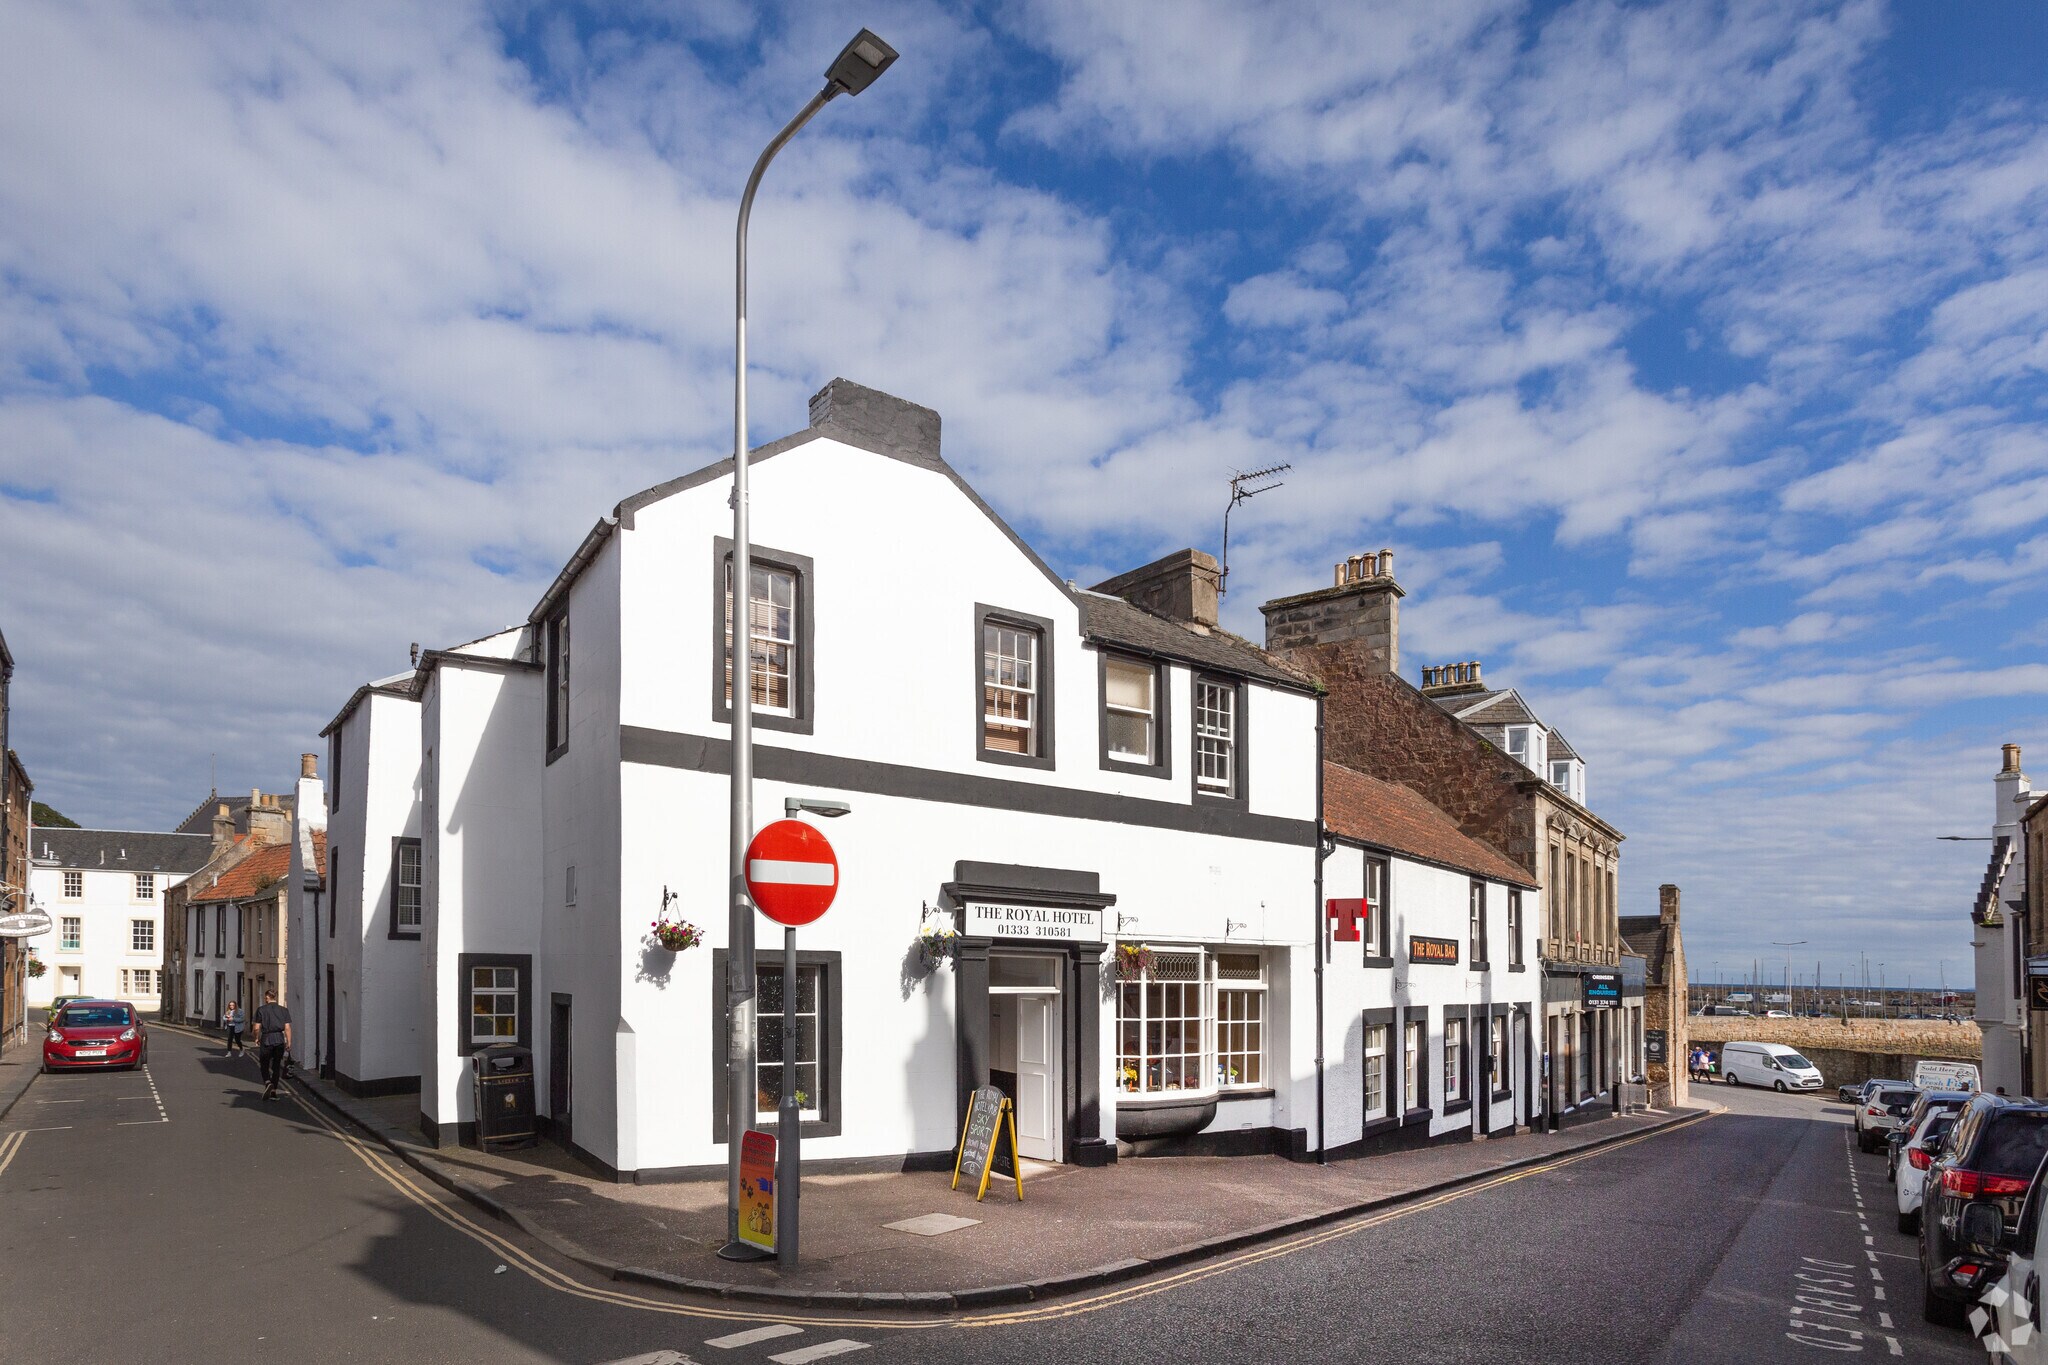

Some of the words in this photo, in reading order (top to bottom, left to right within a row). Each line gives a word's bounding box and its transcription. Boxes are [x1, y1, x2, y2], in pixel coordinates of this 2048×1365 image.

[975, 906, 1002, 920] THE
[1006, 908, 1049, 922] ROYAL
[1053, 911, 1094, 925] HOTEL
[998, 924, 1029, 935] 01333
[1035, 926, 1071, 938] 310581
[1413, 941, 1425, 957] THE
[1426, 942, 1444, 958] ROYAL
[1445, 943, 1456, 959] BAR
[976, 1113, 990, 1125] SKY
[970, 1123, 992, 1139] SPORT
[1785, 1257, 1863, 1351] DISABLED
